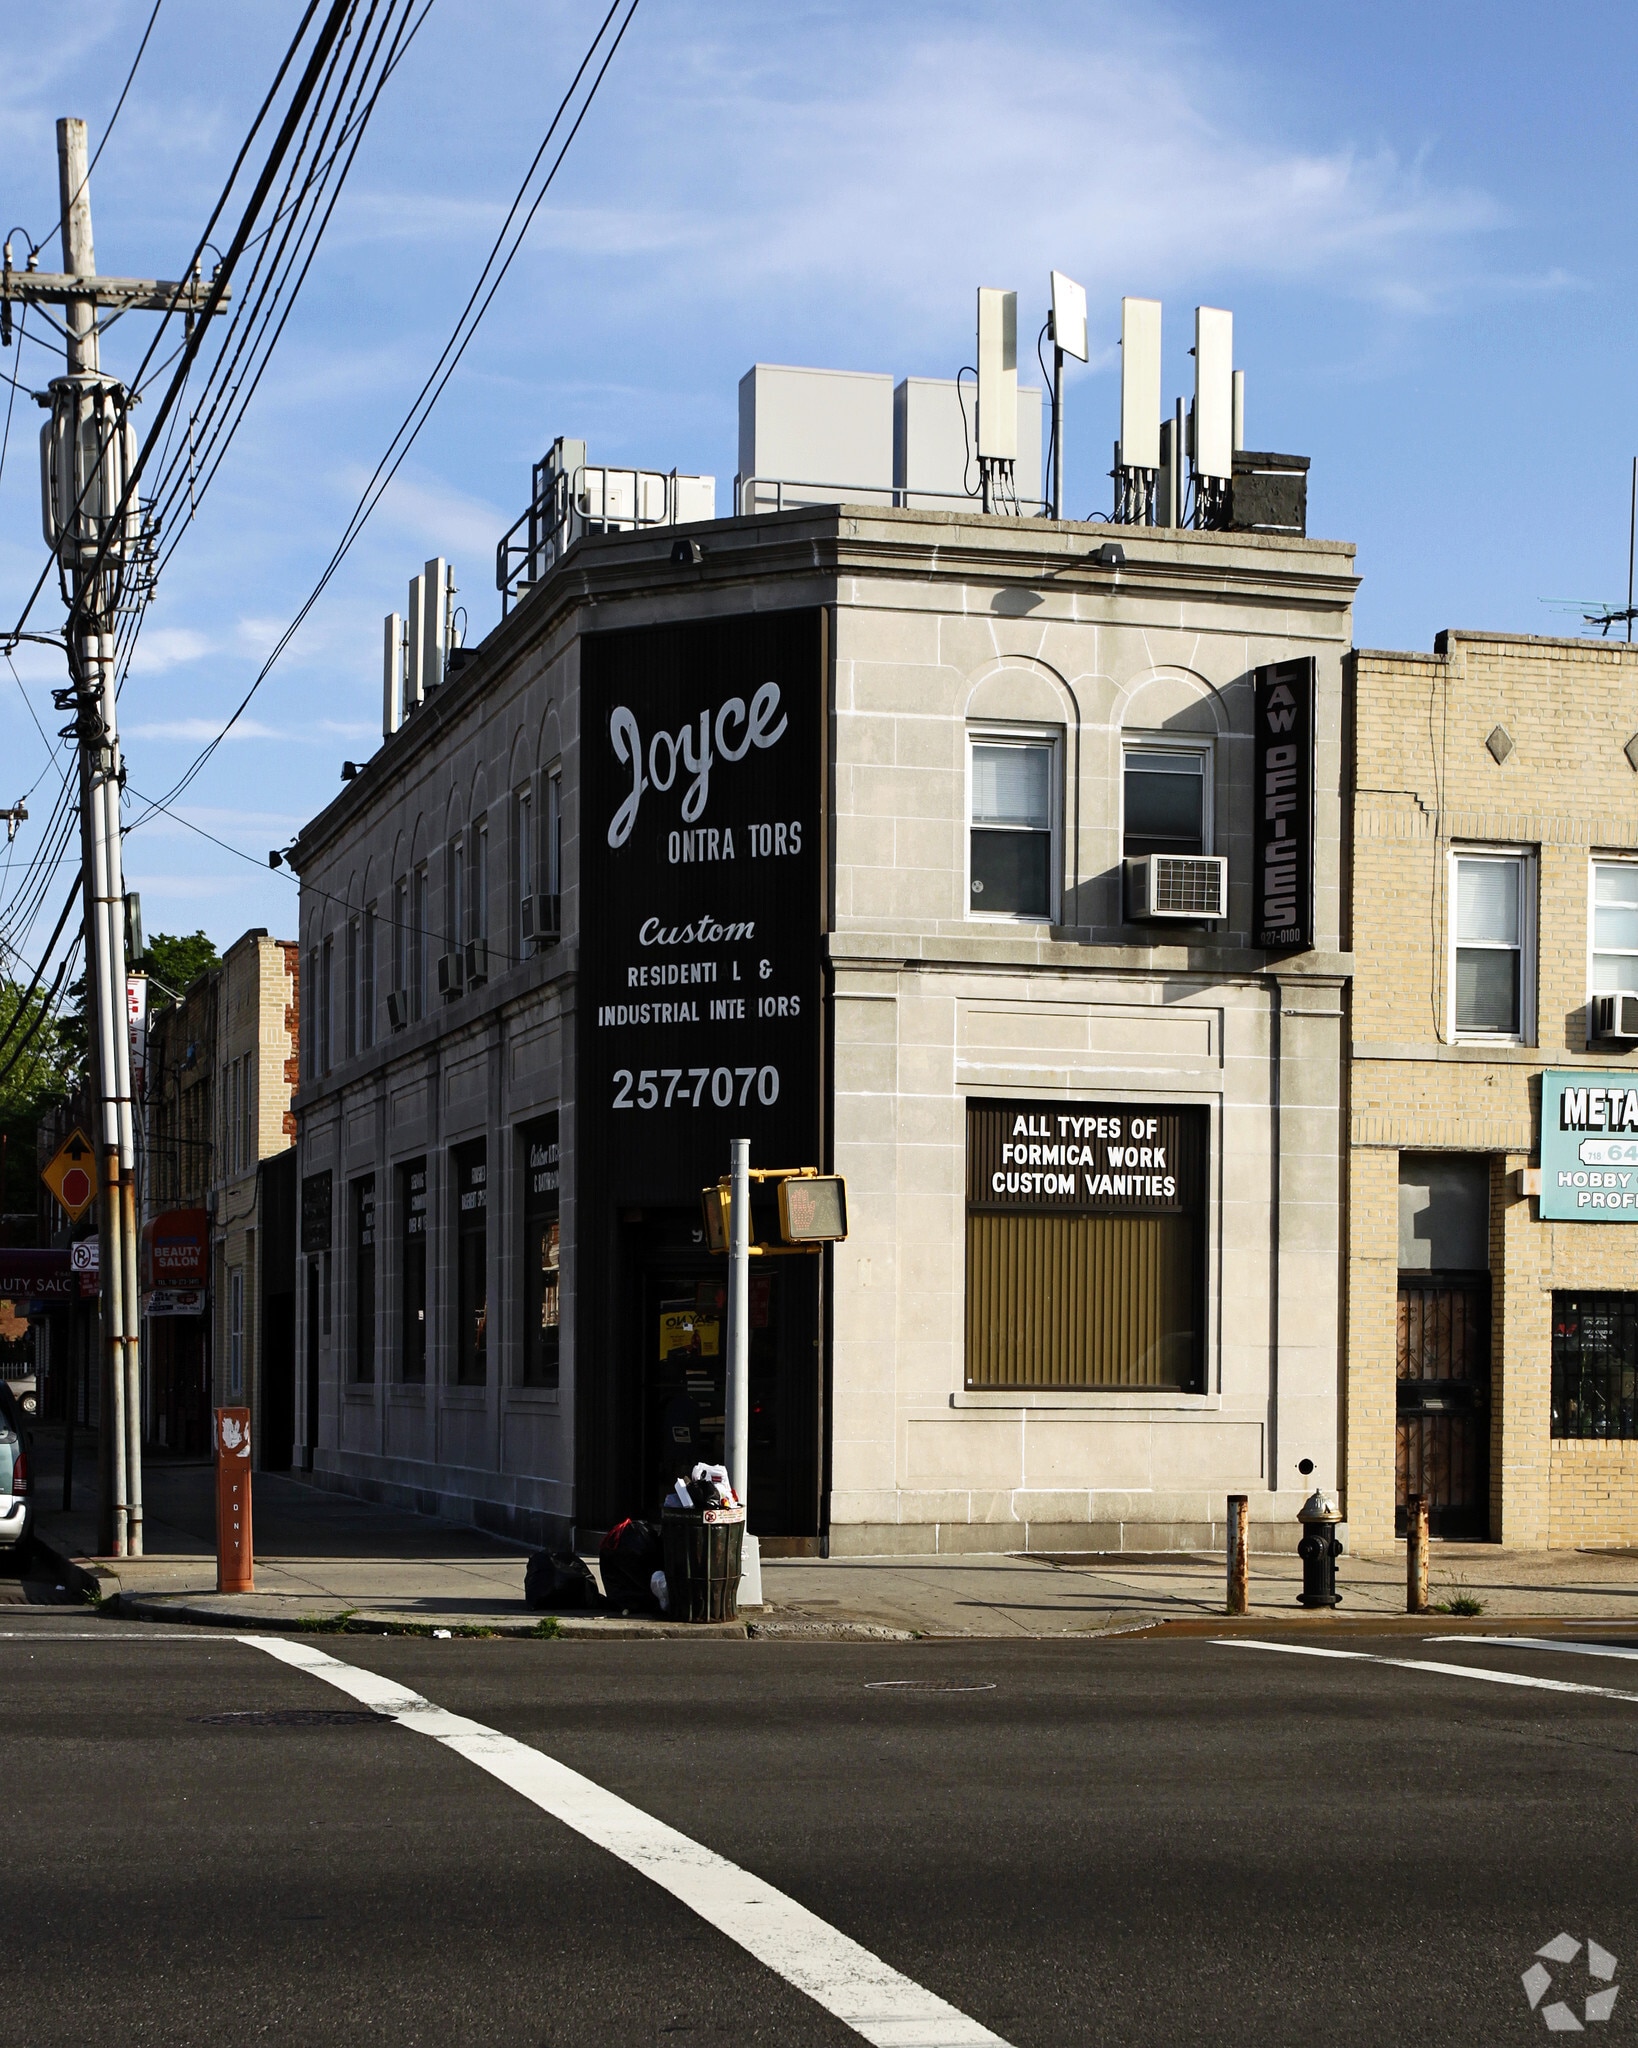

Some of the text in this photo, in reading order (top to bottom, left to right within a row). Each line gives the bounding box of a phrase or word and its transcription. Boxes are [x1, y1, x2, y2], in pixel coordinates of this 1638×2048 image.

[607, 681, 788, 848] Joyce
[1263, 664, 1298, 928] LAW OFFICES
[638, 915, 755, 946] Custom
[759, 959, 773, 979] &
[598, 1001, 700, 1026] INDUSTRIAL
[612, 1065, 780, 1109] 257-7070
[1560, 1087, 1638, 1131] META
[1012, 1115, 1157, 1140] ALL TYPES OF
[1002, 1143, 1166, 1168] FORMICA WORK
[1588, 1152, 1602, 1160] 718
[992, 1172, 1176, 1197] CUSTOM VANITIES
[1557, 1171, 1632, 1188] HOBBY
[1577, 1191, 1638, 1208] PROF
[154, 1247, 202, 1257] BEAUTY
[159, 1257, 199, 1267] SALON
[232, 1484, 240, 1548] FDNY
